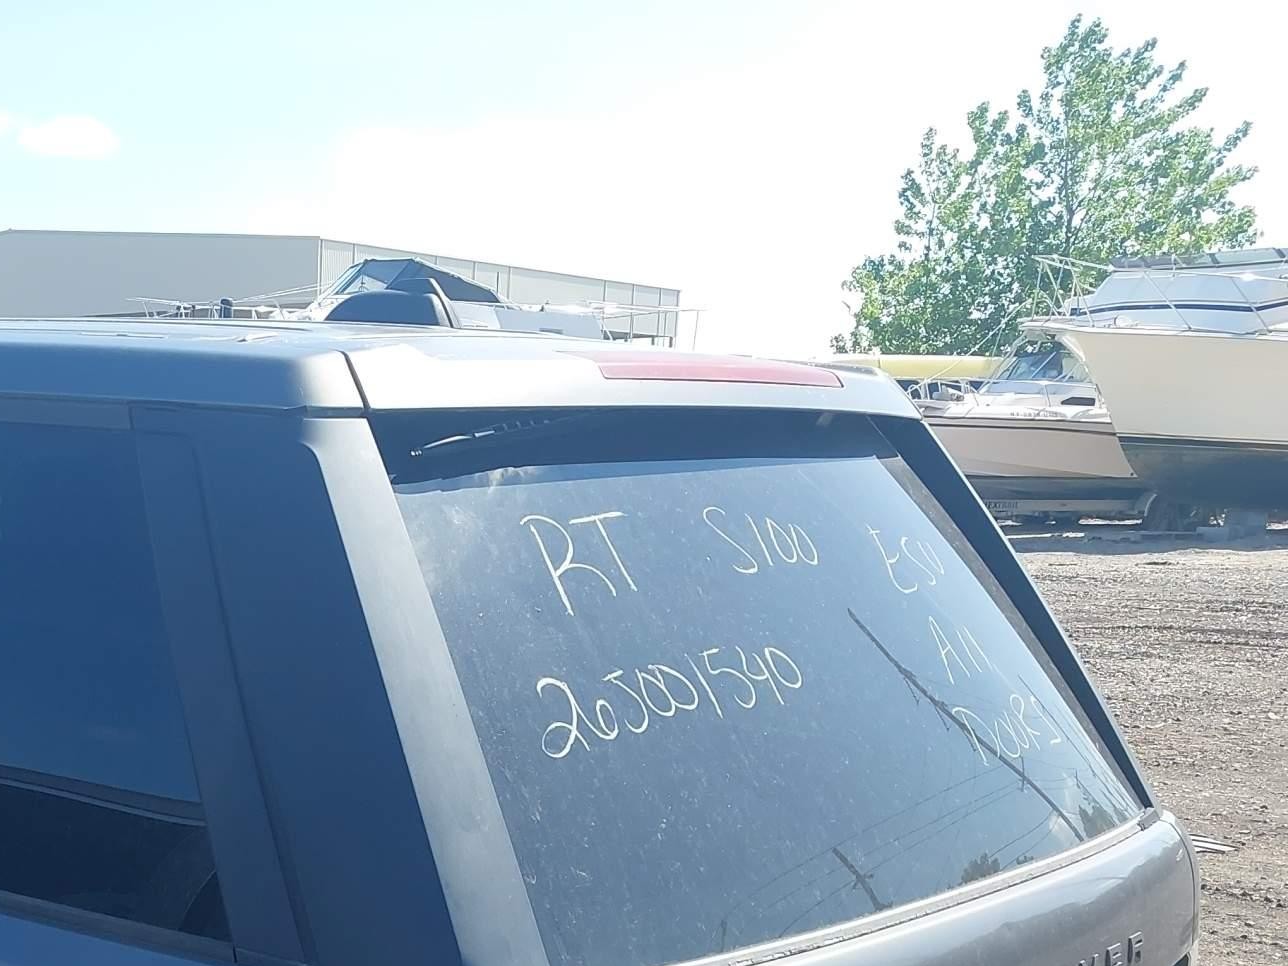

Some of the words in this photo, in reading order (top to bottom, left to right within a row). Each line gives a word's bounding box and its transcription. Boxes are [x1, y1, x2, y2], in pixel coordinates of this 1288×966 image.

[519, 510, 638, 616] RT
[702, 506, 819, 574] S100
[865, 522, 945, 594] ESU
